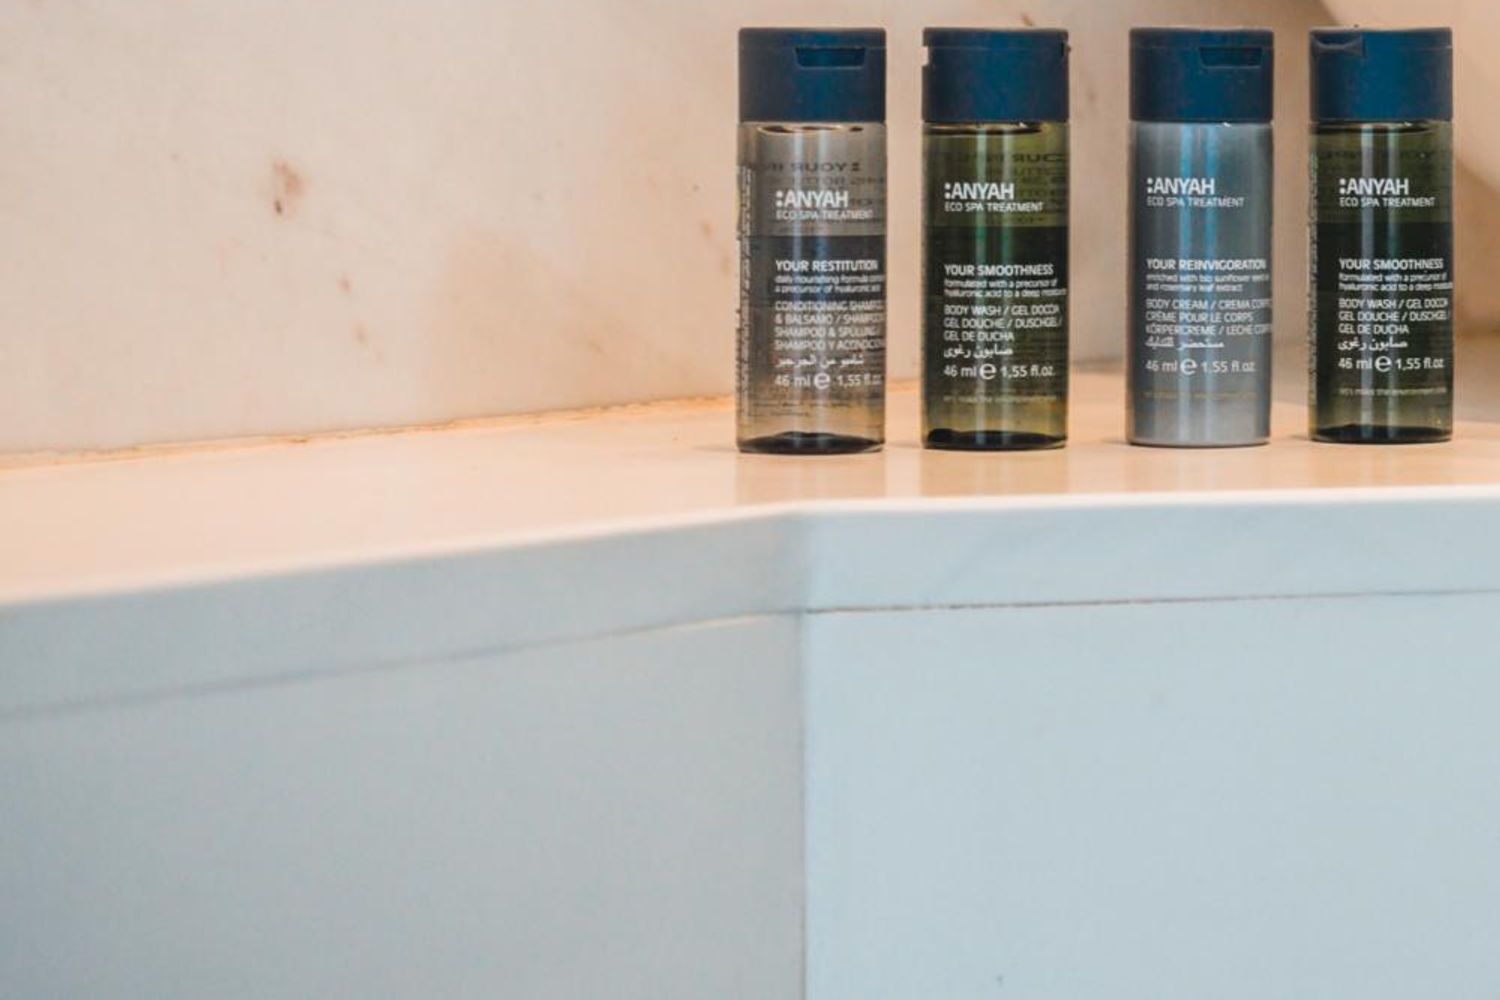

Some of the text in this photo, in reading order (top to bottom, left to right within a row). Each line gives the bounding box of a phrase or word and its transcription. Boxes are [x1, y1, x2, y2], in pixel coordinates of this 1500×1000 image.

[944, 202, 1043, 212] ECO SPA TREATMENT
[1146, 197, 1244, 207] ECO SPA TREATMENT
[1339, 197, 1435, 207] ECO SPA TREATMENT
[776, 210, 874, 220] ECO SPA TREATMENT
[775, 260, 879, 272] YOUR RESTITUTION
[1146, 259, 1267, 270] YOUR REINVIGORATION
[1339, 258, 1443, 270] YOUR SMOOTHNESS
[944, 264, 1054, 276] YOUR SMOOTHNESS
[1180, 274, 1198, 282] with
[1385, 273, 1402, 282] with
[988, 280, 1008, 288] with
[775, 301, 848, 311] CONDITIONING
[1146, 299, 1169, 310] BODY
[1172, 299, 1208, 310] CREAM
[1218, 299, 1250, 310] CREMA
[1339, 298, 1364, 309] BODY
[1366, 298, 1397, 309] WASH
[1405, 298, 1423, 309] GEL
[944, 304, 968, 315] BODY
[971, 304, 1001, 315] WASH
[1011, 304, 1029, 315] GEL
[785, 313, 833, 324] BALSAMO
[1179, 312, 1208, 323] POUR
[1210, 312, 1222, 323] LE
[1224, 312, 1254, 323] CORPS
[1338, 310, 1355, 321] GEL
[1357, 310, 1400, 321] DOUCHE
[943, 318, 960, 328] GEL
[961, 318, 1005, 328] DOUCHE
[1015, 318, 1057, 328] DUSCHGEL
[1145, 322, 1217, 334] KÖRPERCREME
[1226, 324, 1253, 334] LECHE
[1338, 324, 1409, 334] GEL DE DUCHA
[943, 331, 1015, 341] GEL DE DUCHA
[828, 340, 836, 350] Y
[1145, 361, 1160, 372] 46
[1162, 361, 1178, 372] ml
[1338, 357, 1353, 369] 46
[1356, 357, 1372, 369] ml
[1395, 358, 1420, 371] 1,55
[943, 365, 958, 378] 46
[961, 365, 977, 378] ml
[1000, 366, 1028, 379] 1,55
[775, 374, 790, 387] 46
[794, 374, 811, 387] ml
[836, 374, 861, 387] 1,55
